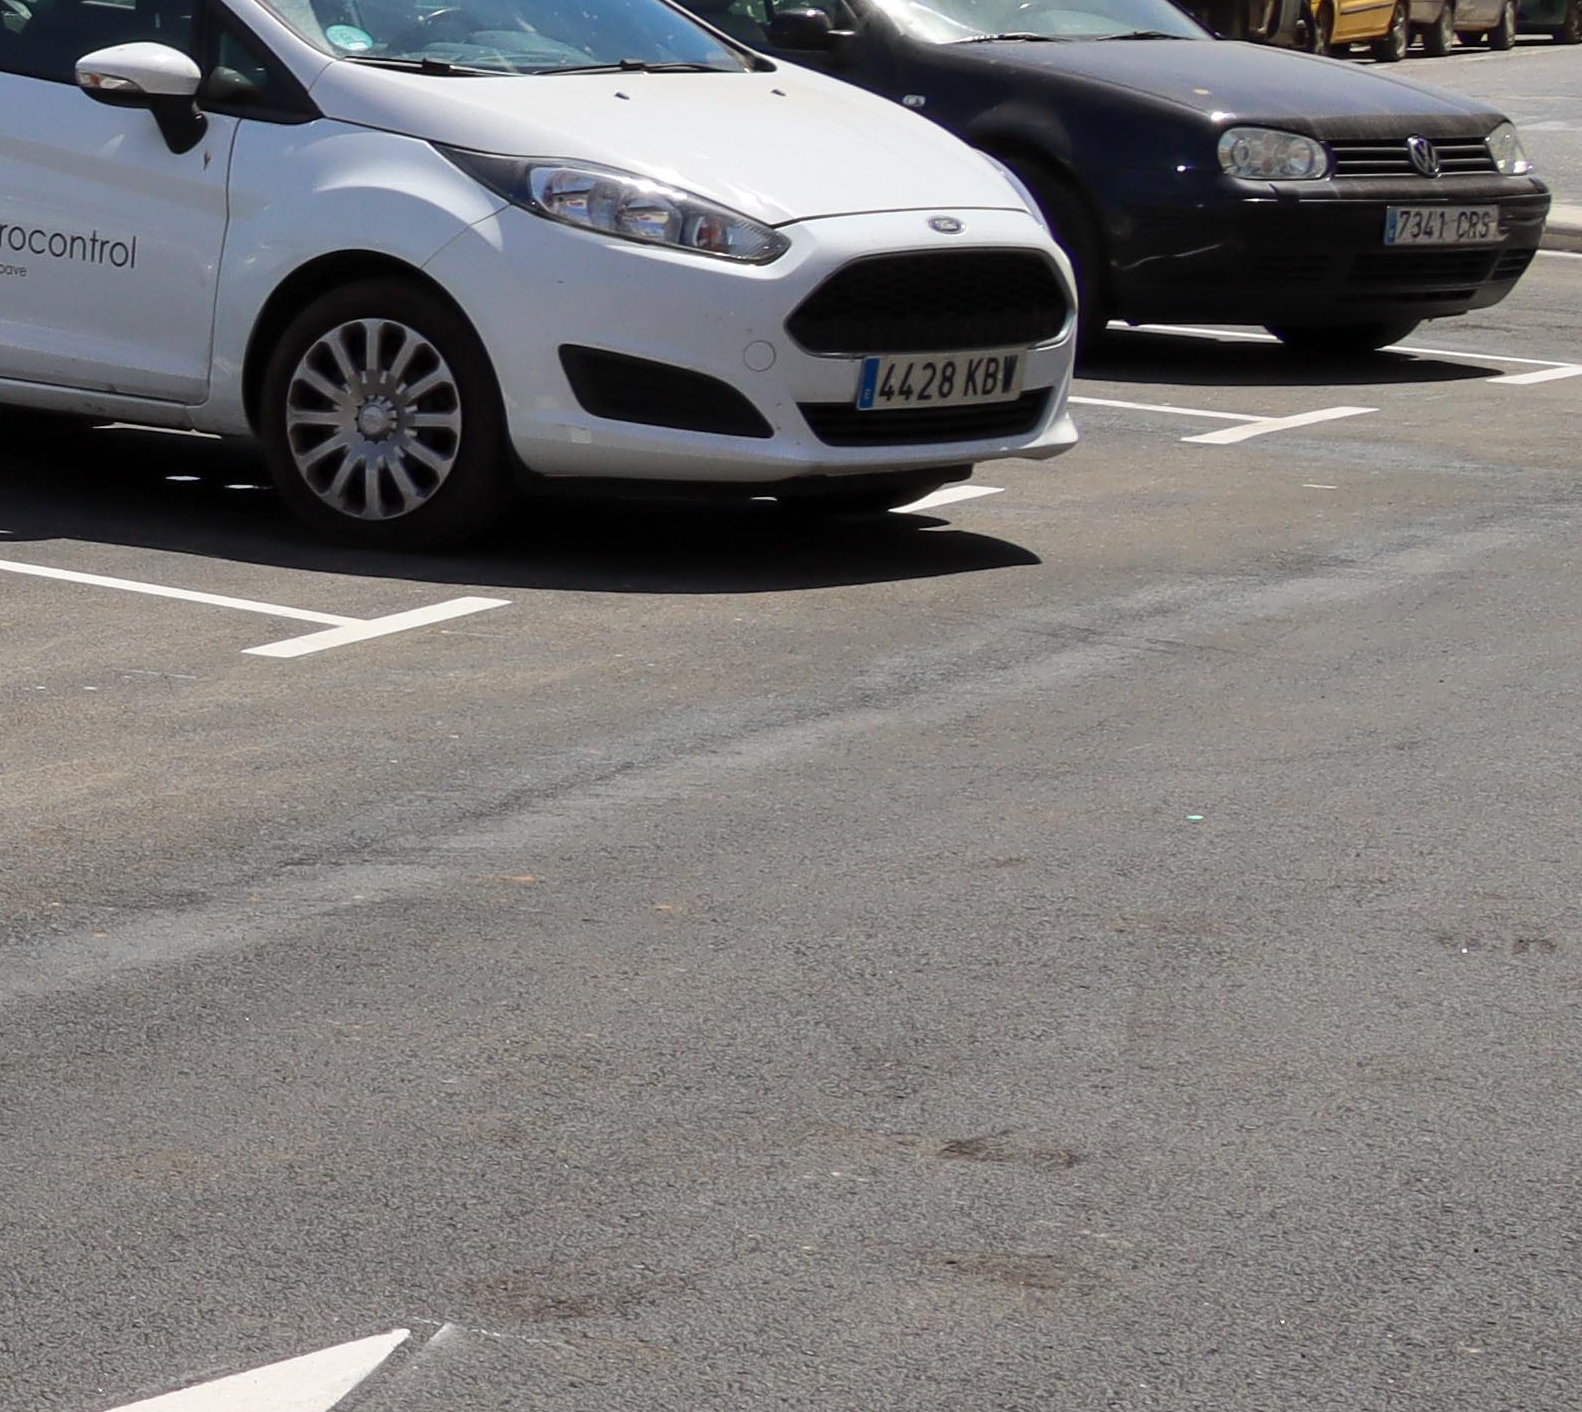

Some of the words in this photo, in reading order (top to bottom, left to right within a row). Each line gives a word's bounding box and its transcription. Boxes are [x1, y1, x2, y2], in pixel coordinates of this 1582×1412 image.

[1397, 210, 1446, 239] 7341
[1456, 211, 1493, 239] CRS
[879, 361, 956, 401] 4428
